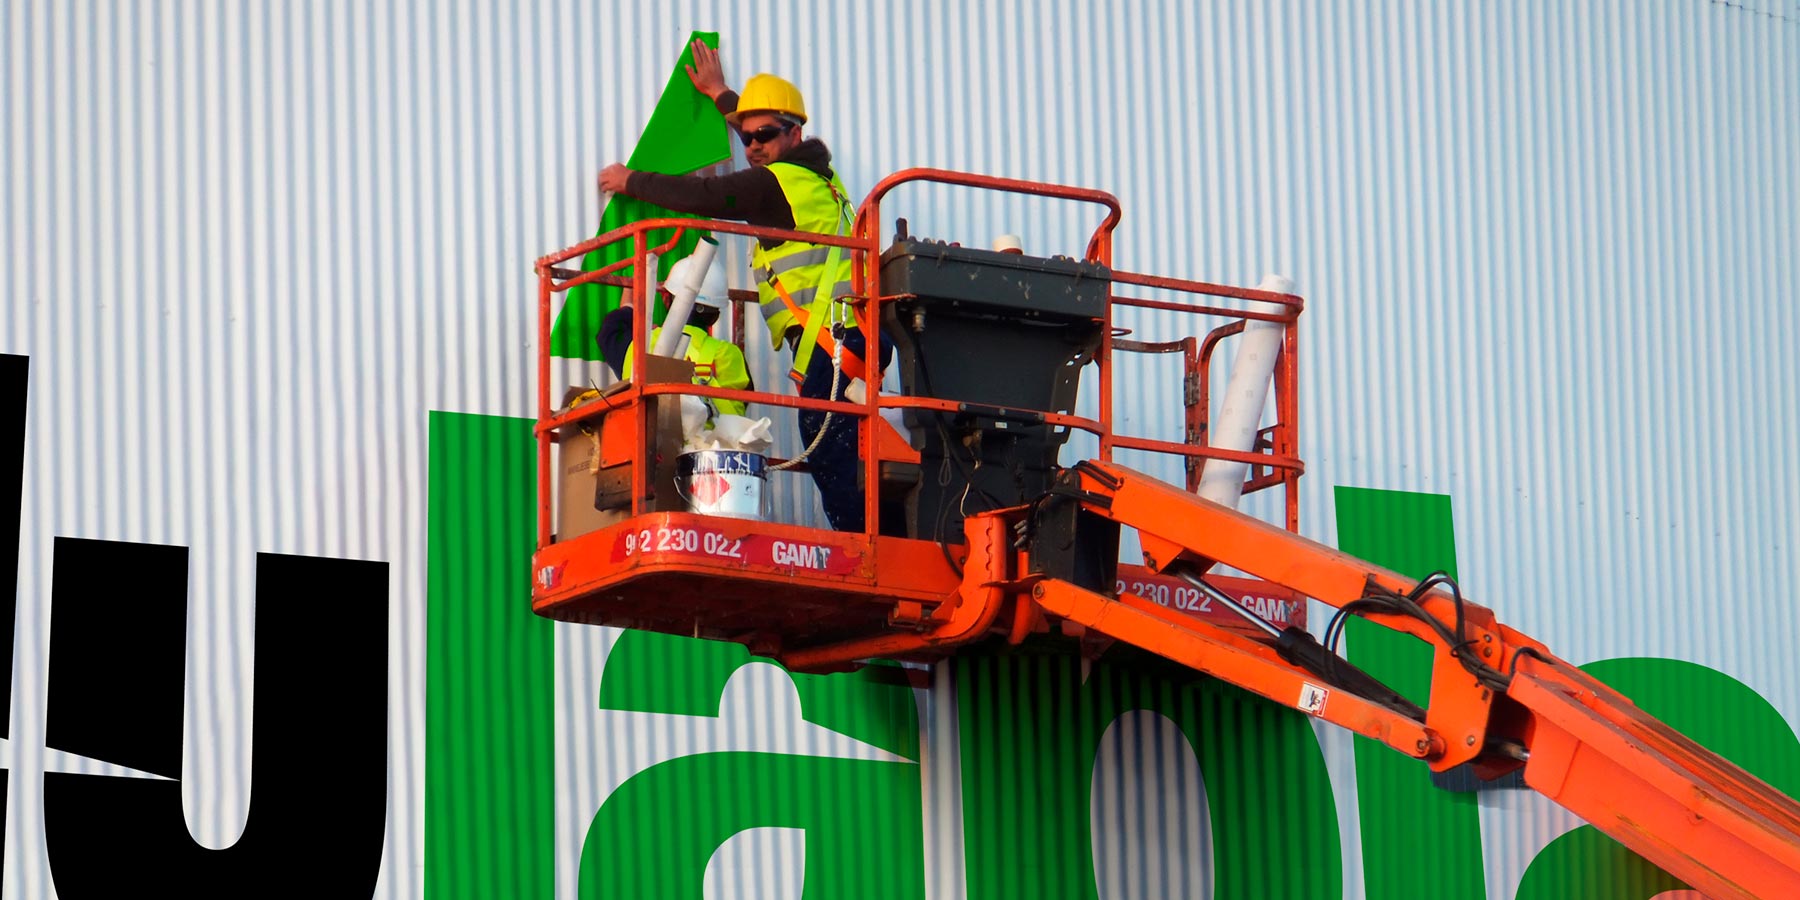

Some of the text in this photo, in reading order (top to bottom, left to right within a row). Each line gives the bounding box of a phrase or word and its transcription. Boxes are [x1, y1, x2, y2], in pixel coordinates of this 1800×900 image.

[625, 528, 742, 558] 92 230 022
[1174, 587, 1212, 612] 022
